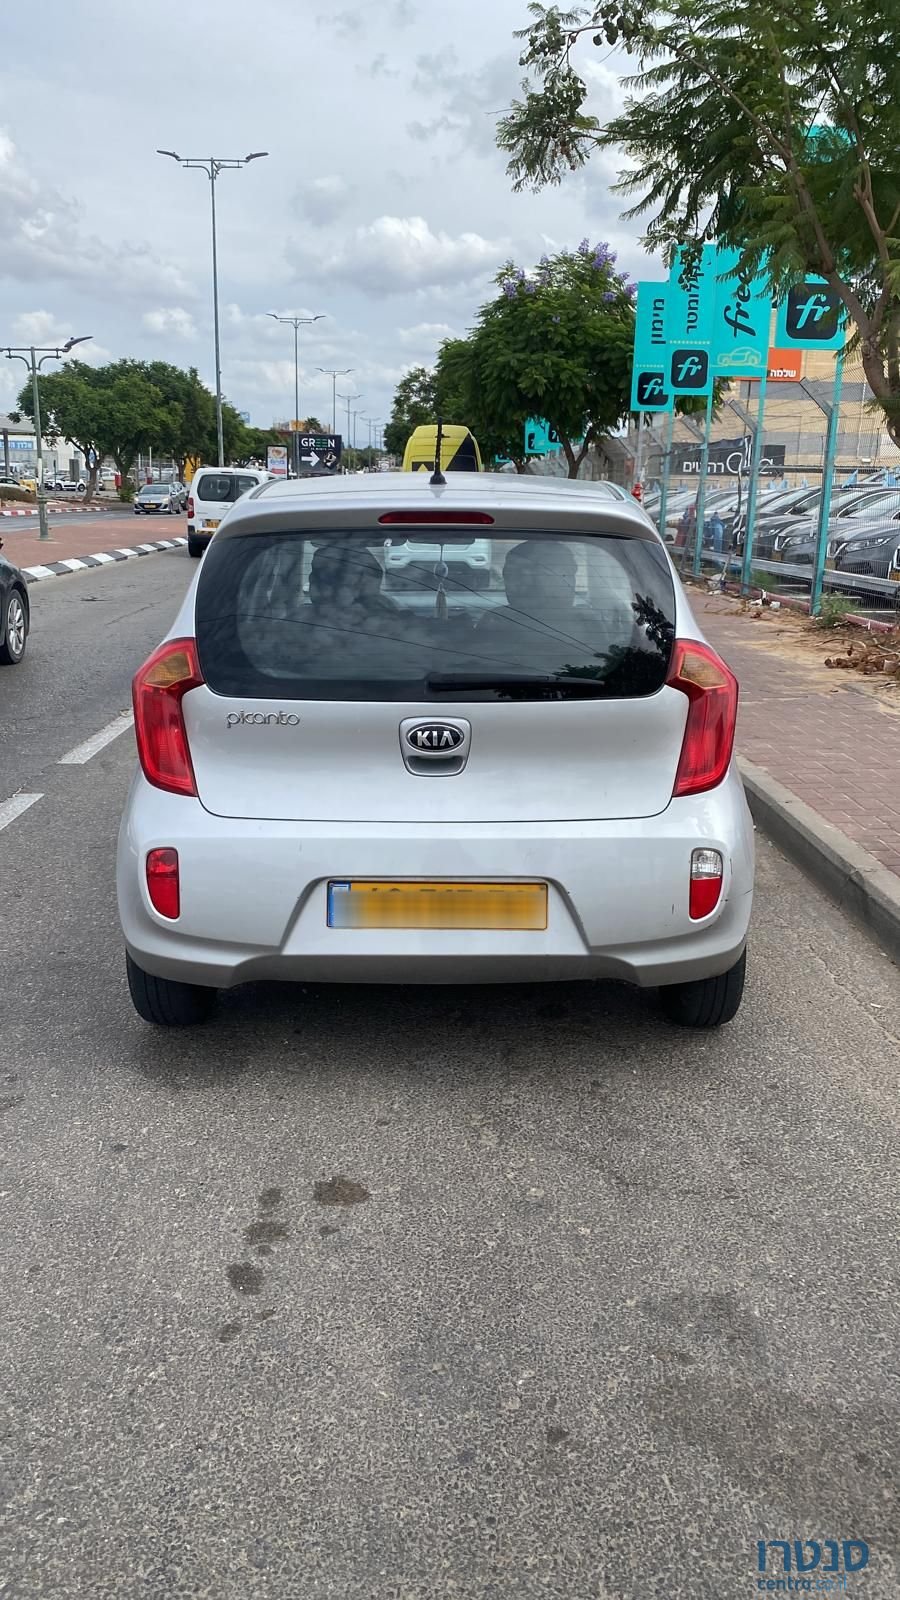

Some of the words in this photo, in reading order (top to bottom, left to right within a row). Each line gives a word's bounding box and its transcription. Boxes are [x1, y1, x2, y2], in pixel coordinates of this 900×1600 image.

[651, 298, 667, 345] מימון
[677, 356, 703, 381] fr
[769, 369, 797, 378] שלמה
[301, 437, 336, 448] GREEN
[225, 710, 301, 729] picanto
[416, 730, 455, 747] KIA
